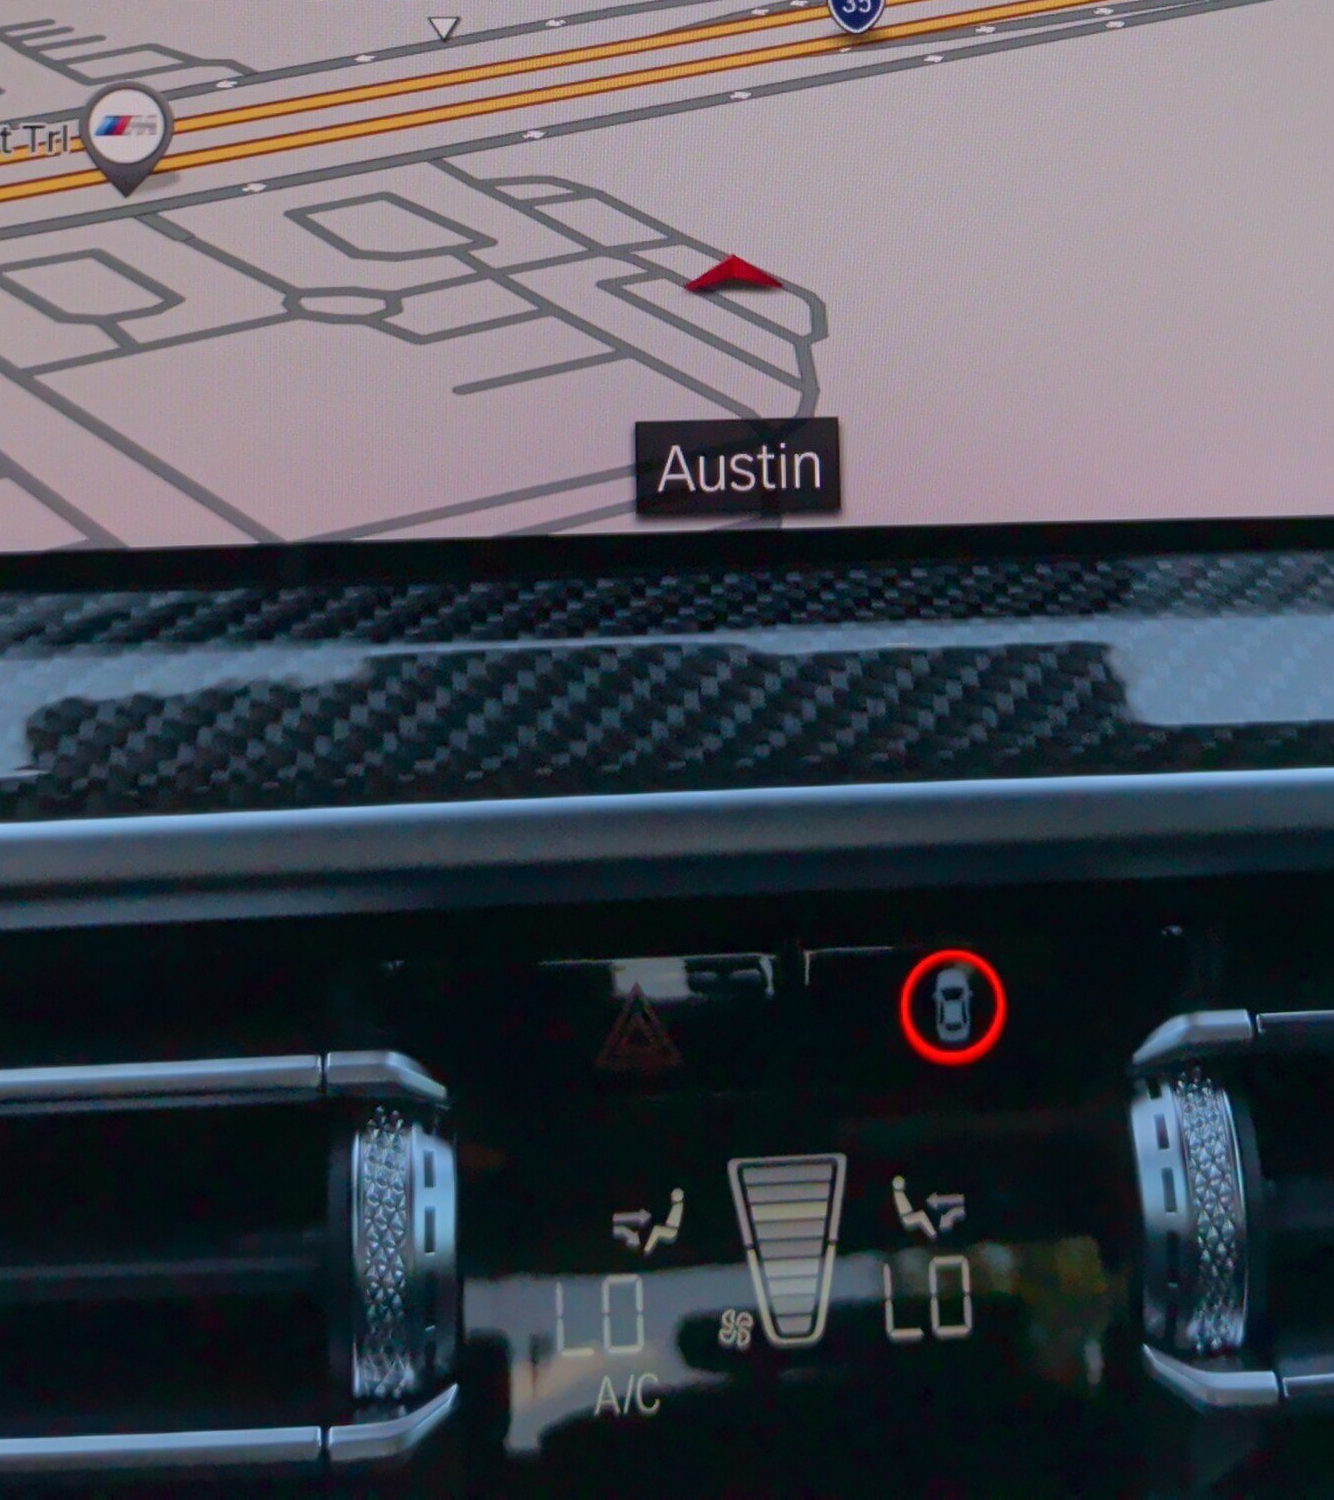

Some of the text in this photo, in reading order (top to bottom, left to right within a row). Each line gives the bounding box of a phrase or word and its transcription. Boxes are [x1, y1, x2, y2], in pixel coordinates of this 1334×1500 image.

[23, 124, 69, 155] Trl
[657, 442, 821, 492] Austin
[593, 1372, 662, 1417] A/C
